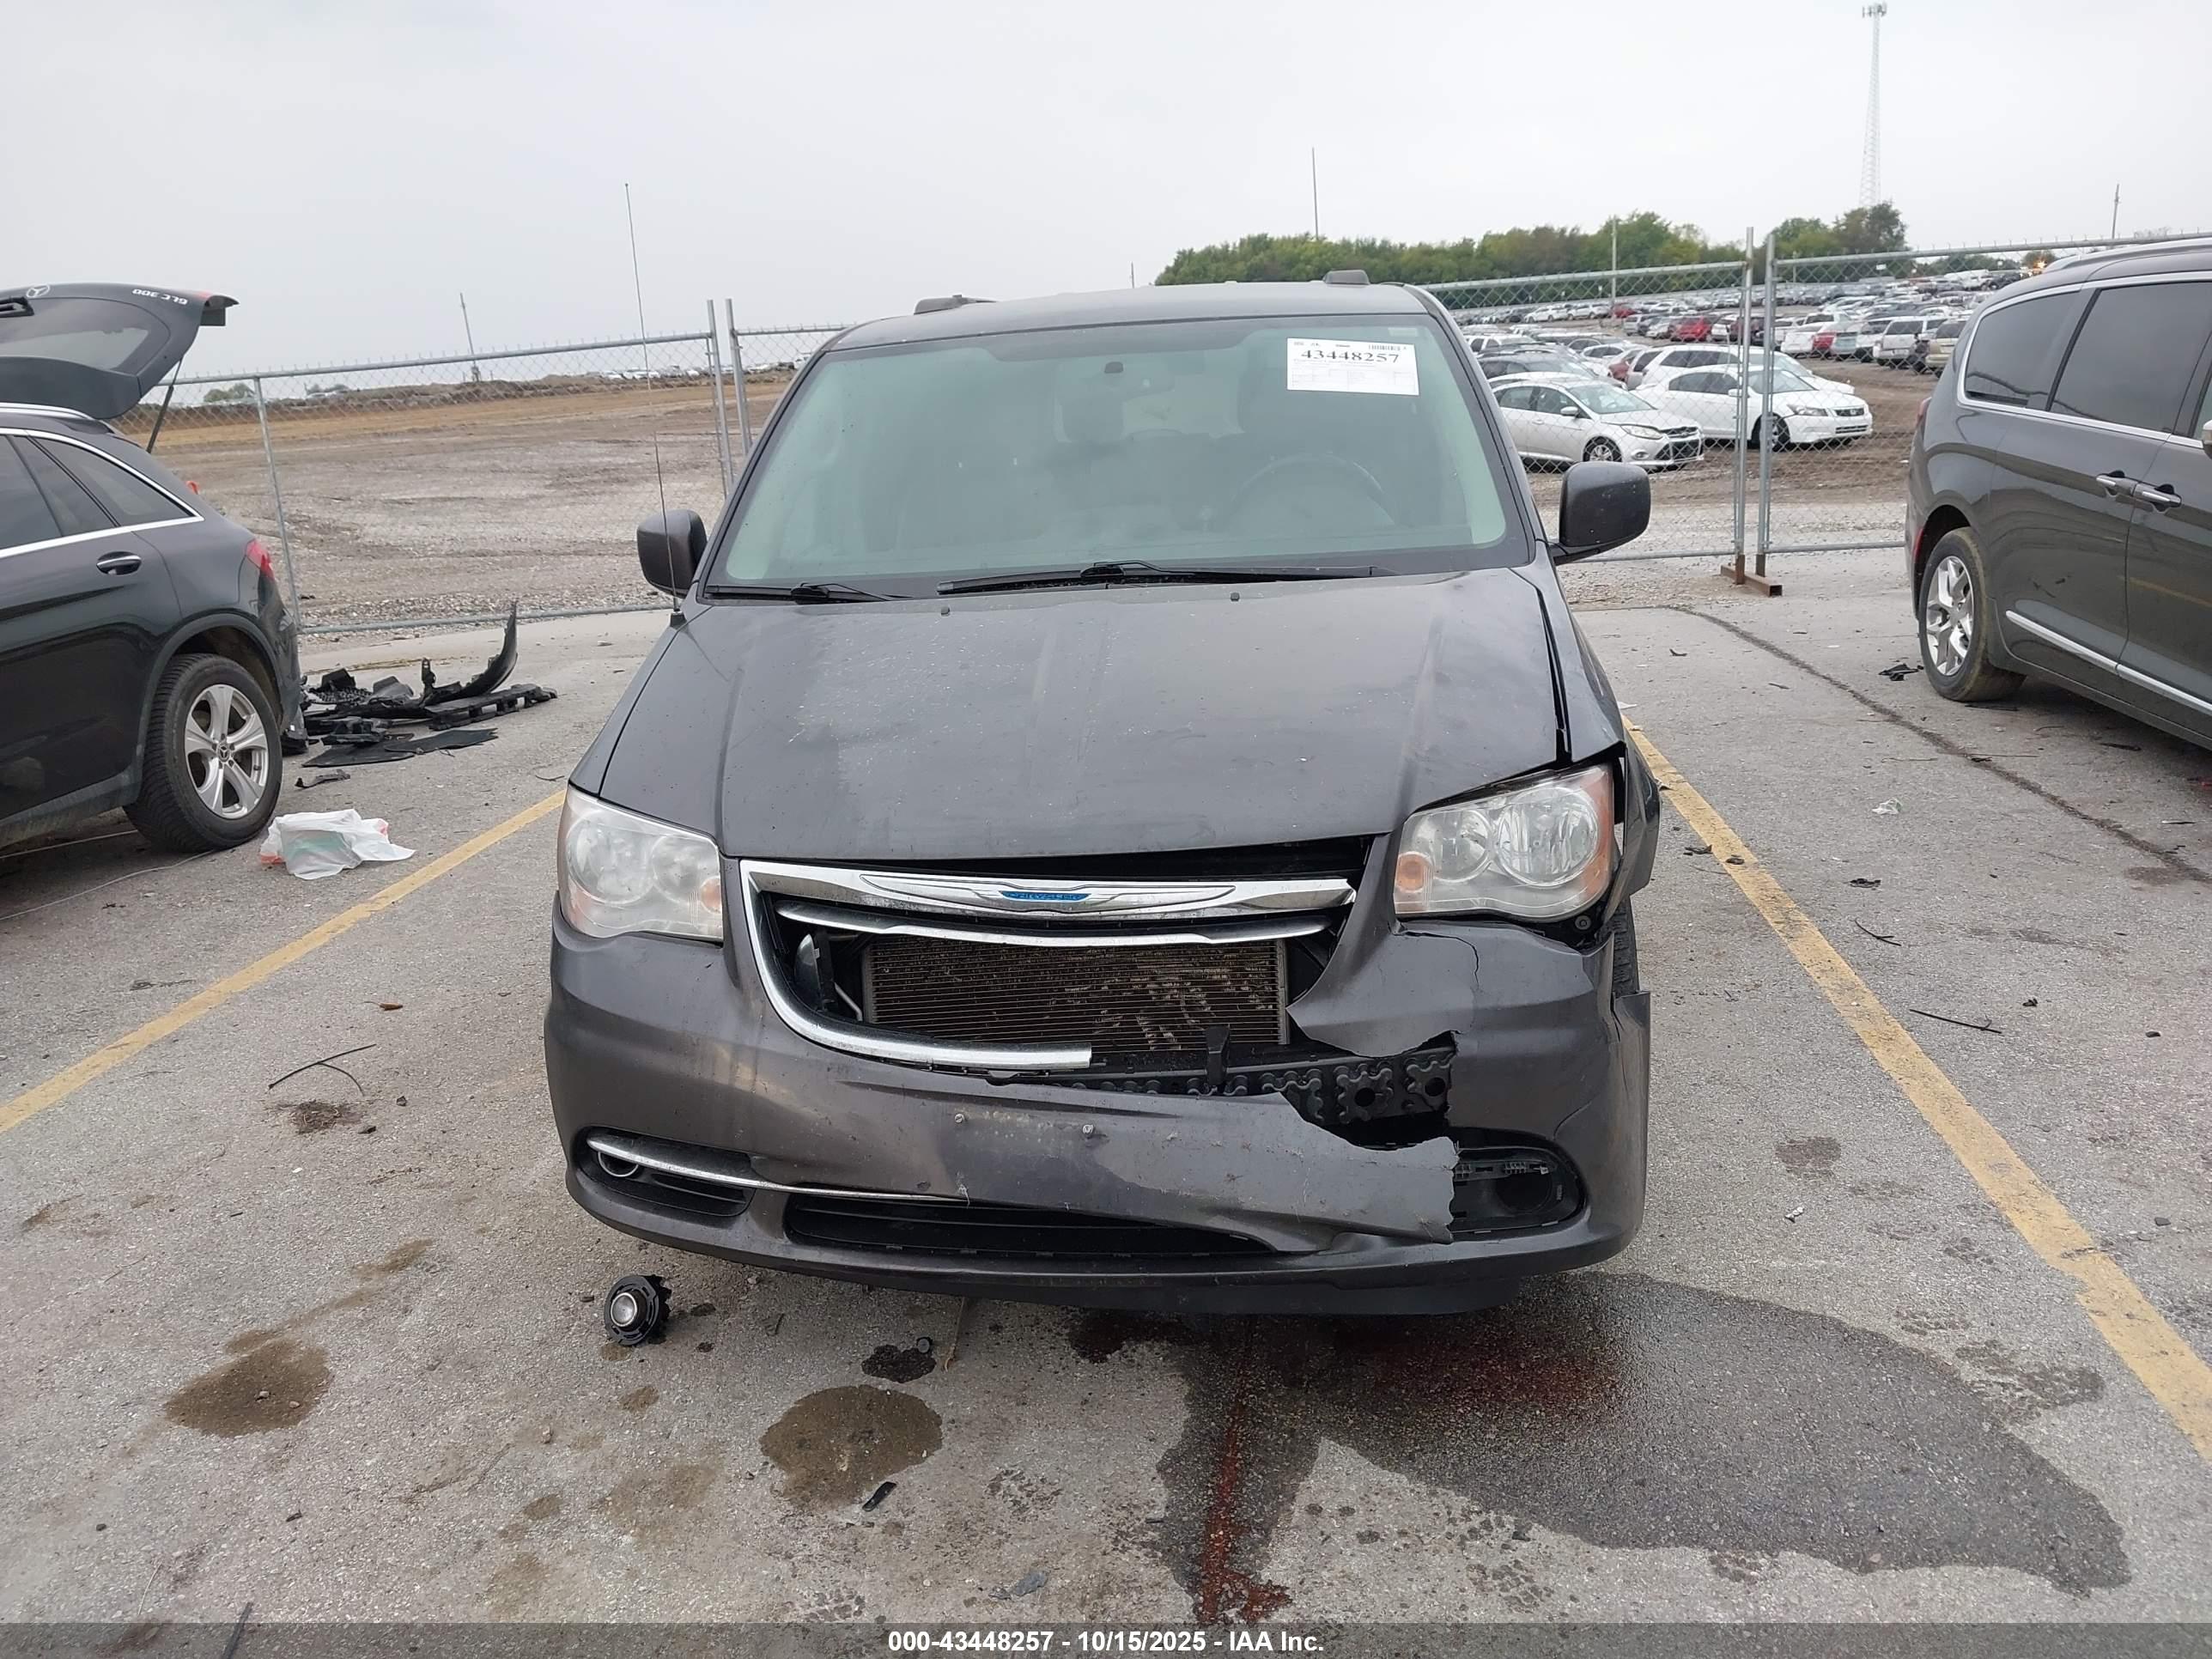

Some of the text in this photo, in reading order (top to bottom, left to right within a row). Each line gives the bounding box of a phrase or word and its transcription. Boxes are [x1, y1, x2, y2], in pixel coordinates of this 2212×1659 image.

[131, 288, 188, 305] GLC 300
[1301, 349, 1400, 363] 43448257
